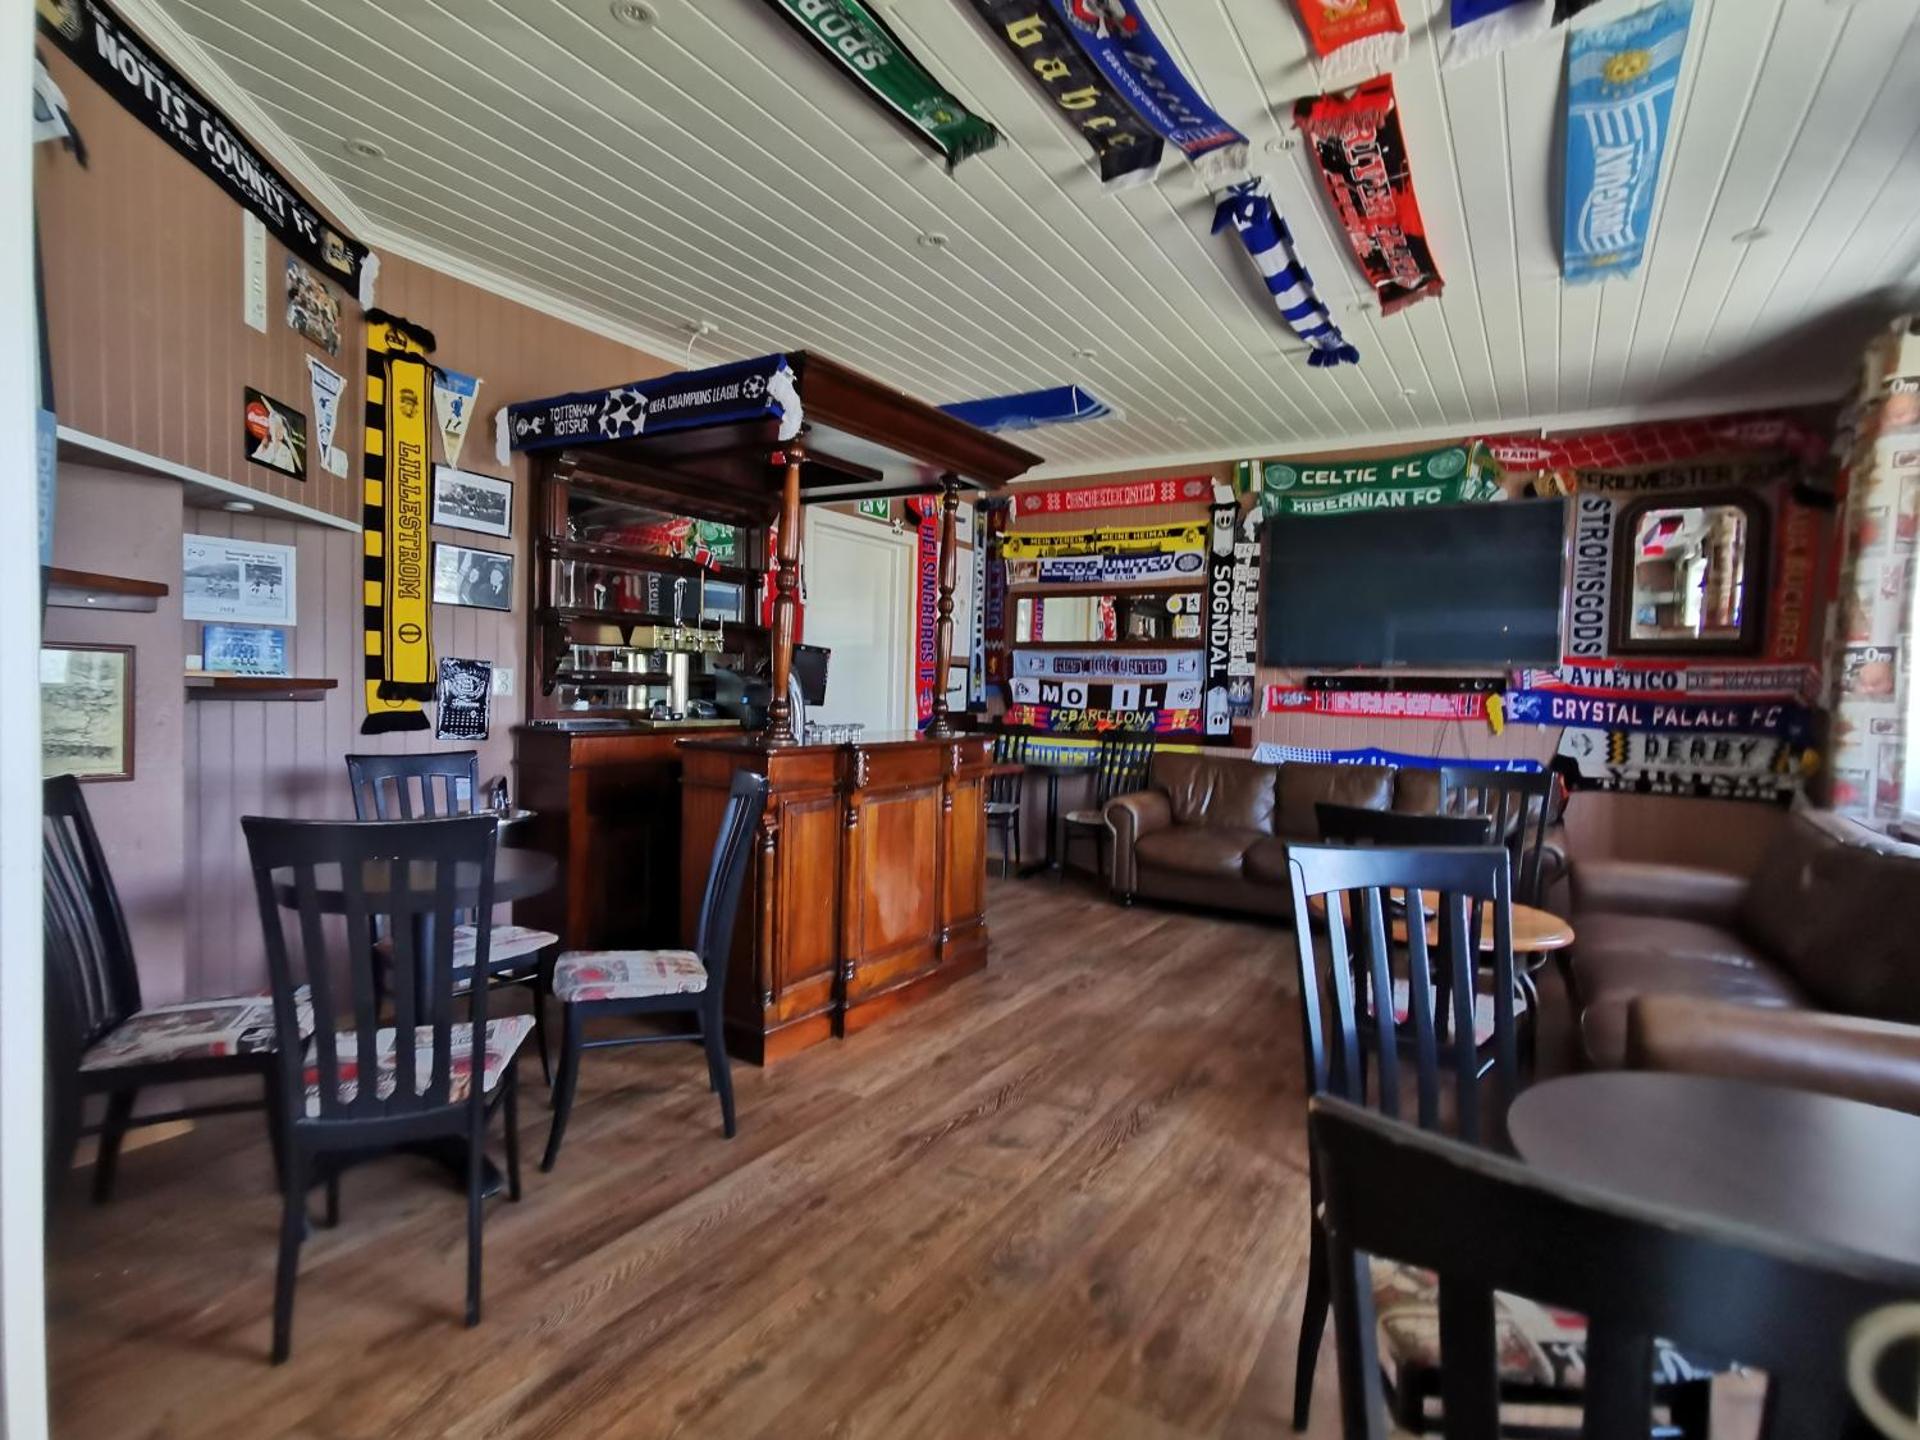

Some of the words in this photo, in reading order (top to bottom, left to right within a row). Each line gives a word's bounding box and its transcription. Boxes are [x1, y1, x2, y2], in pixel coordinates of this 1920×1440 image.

[96, 22, 190, 131] NOTTS
[200, 119, 287, 217] COUNTY
[291, 207, 318, 245] FC
[156, 110, 200, 152] THE
[210, 156, 286, 229] MAGPIES
[667, 388, 712, 412] CHAMPIONS
[712, 382, 741, 403] LEAGUE
[549, 403, 598, 422] TOTTENHAM
[554, 419, 590, 438] HOTSPUR
[1494, 448, 1541, 461] BRANN
[1301, 466, 1378, 486] CELTIC
[1391, 460, 1422, 480] FC
[1292, 490, 1406, 514] HIBERNIAN
[1412, 487, 1443, 506] FC
[398, 440, 421, 600] LILLESTROM
[1031, 536, 1051, 546] MEIN
[1101, 532, 1130, 541] MEINE
[1040, 557, 1099, 578] LEEDS
[1103, 552, 1174, 576] UNITED
[1114, 573, 1136, 582] CLUB
[920, 525, 935, 662] HELSINGBORGS
[1210, 565, 1231, 678] SOGNDAL
[920, 666, 934, 688] IF
[1552, 697, 1643, 726] CRYSTAL
[1644, 734, 1760, 764] DERBY
